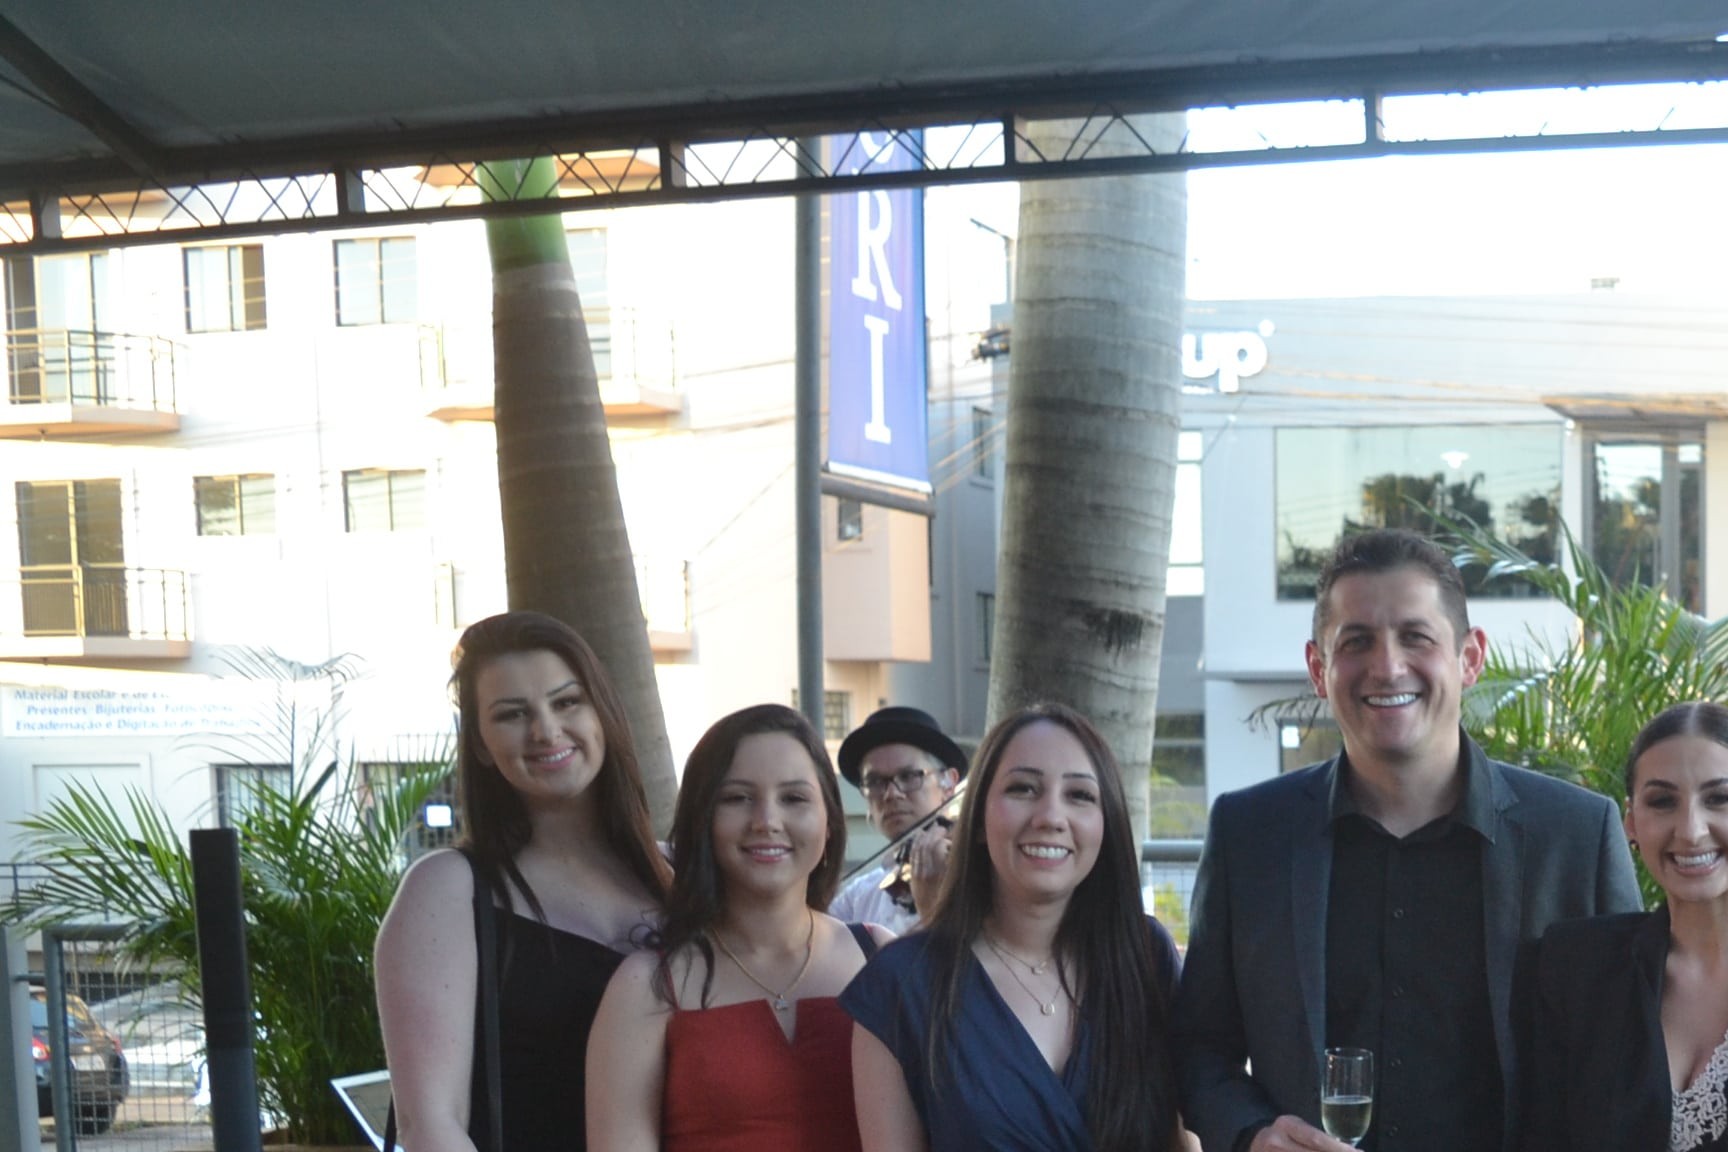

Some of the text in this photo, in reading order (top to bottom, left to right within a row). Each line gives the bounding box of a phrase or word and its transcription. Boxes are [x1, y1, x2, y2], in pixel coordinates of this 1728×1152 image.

[14, 689, 68, 700] Material
[73, 689, 117, 700] Escolar
[27, 705, 88, 715] Presentes
[95, 704, 155, 716] Bijuterias
[16, 720, 102, 731] Encadernação
